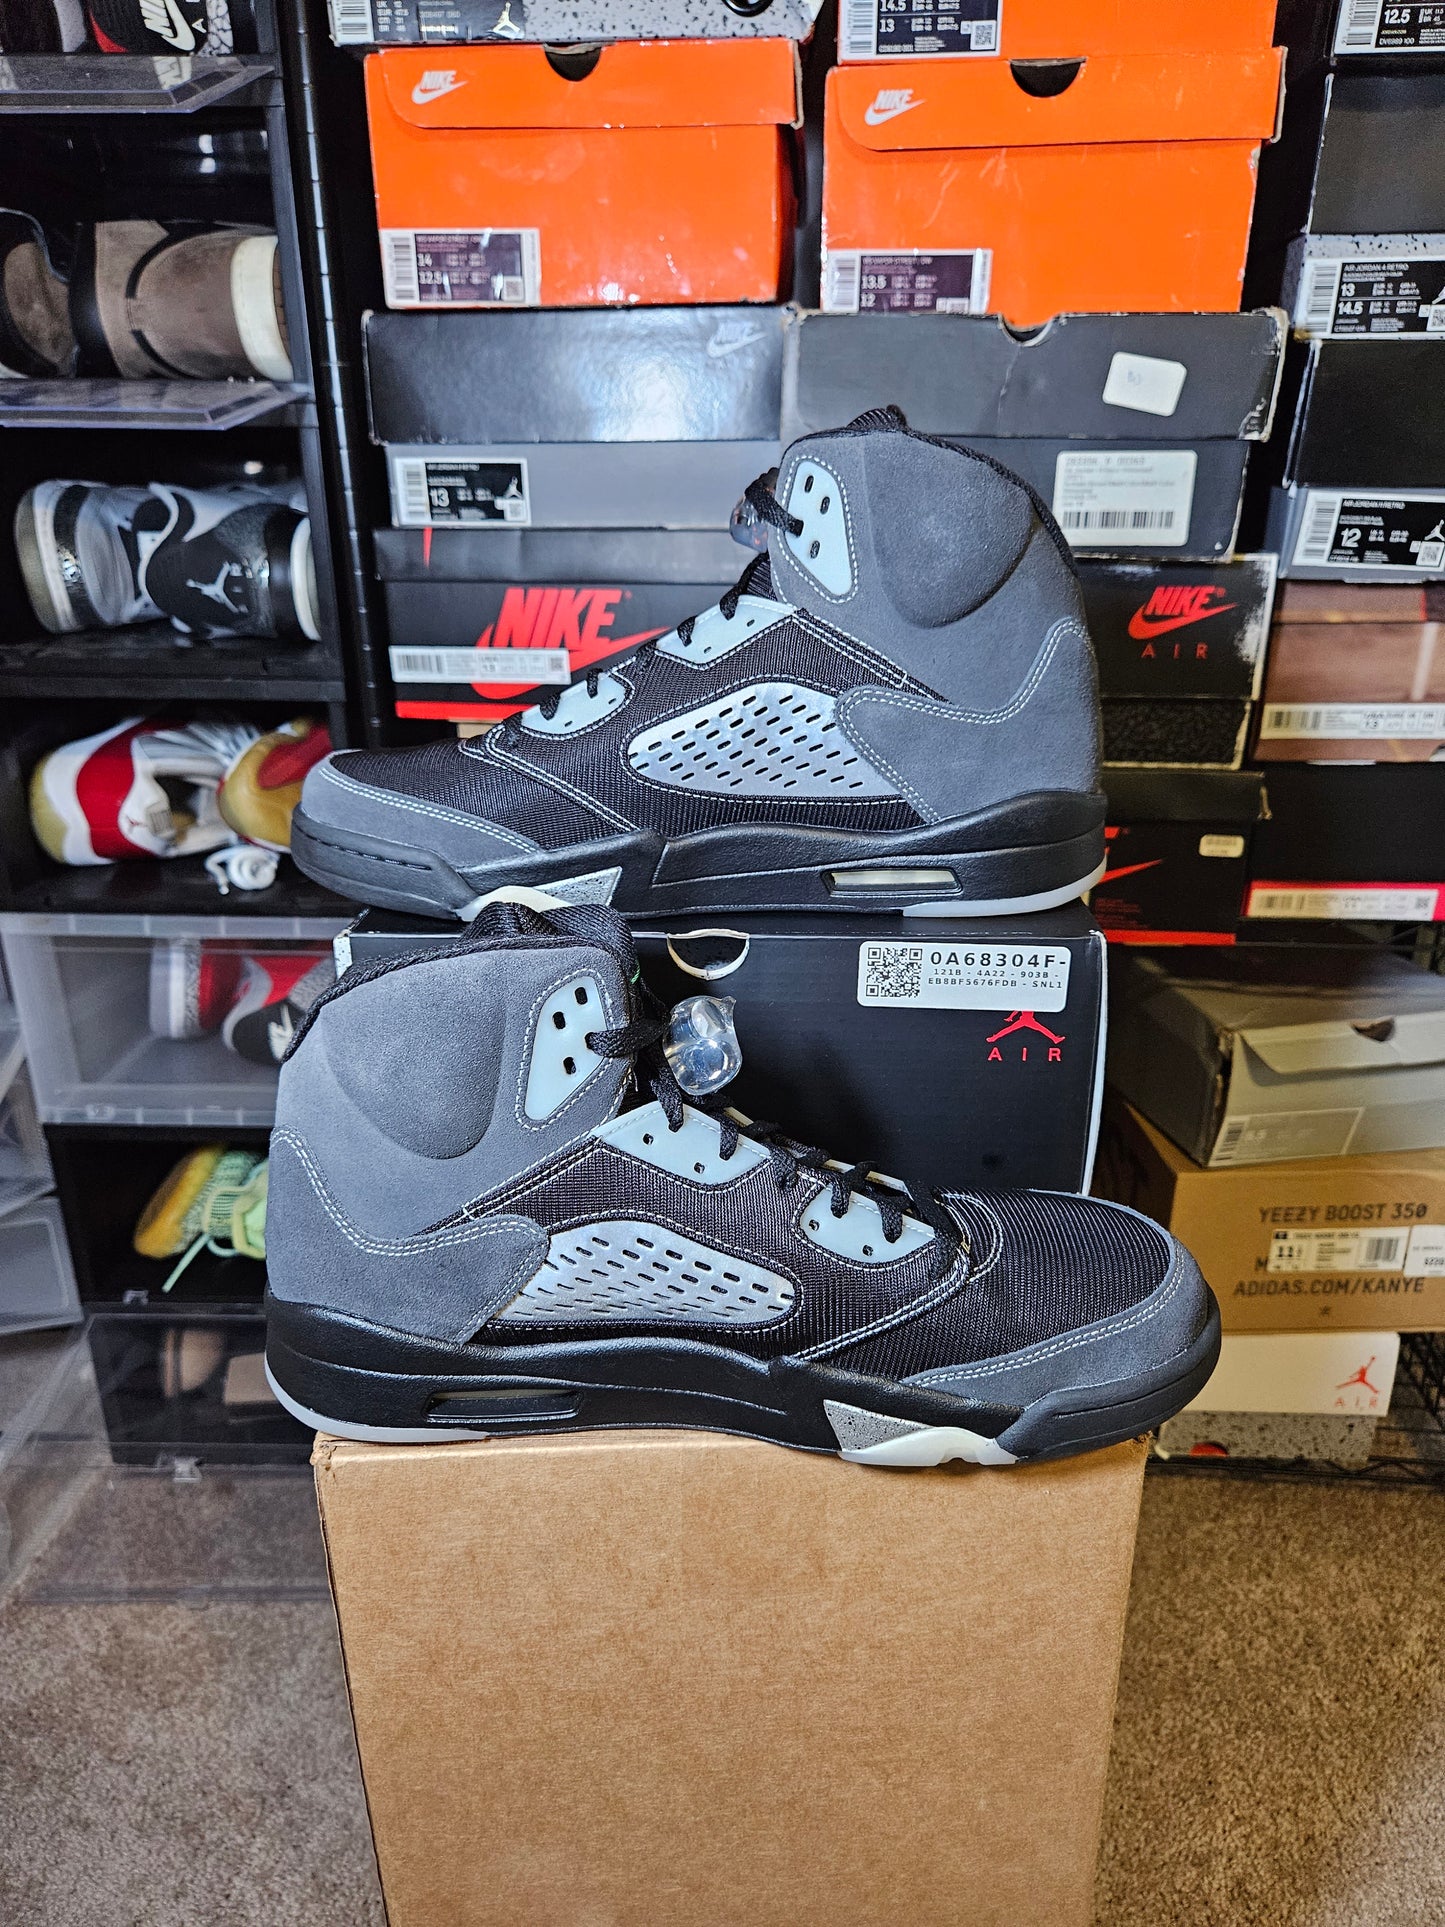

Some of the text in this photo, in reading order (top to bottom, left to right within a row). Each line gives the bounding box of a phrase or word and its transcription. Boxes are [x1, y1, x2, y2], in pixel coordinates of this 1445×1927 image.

[1384, 8, 1411, 24] 12.5
[879, 19, 895, 32] 13
[419, 70, 457, 89] NIKE
[874, 89, 914, 109] NIKE
[417, 253, 433, 267] 14
[862, 275, 887, 290] 13.5
[1341, 283, 1356, 297] 13
[861, 293, 876, 308] 12
[1338, 301, 1364, 315] 14.5
[429, 487, 450, 507] 13
[1341, 528, 1362, 548] 12
[1144, 585, 1217, 615] NIKE
[493, 586, 622, 649] NIKE
[1141, 642, 1208, 659] AIR
[930, 950, 1067, 968] 0A68304F-
[934, 968, 962, 976] 121B
[987, 1047, 1062, 1062] AIR
[1259, 1202, 1428, 1222] YEEZY BOOST 350
[1234, 1276, 1426, 1296] ADIDAS.COM/KANYE
